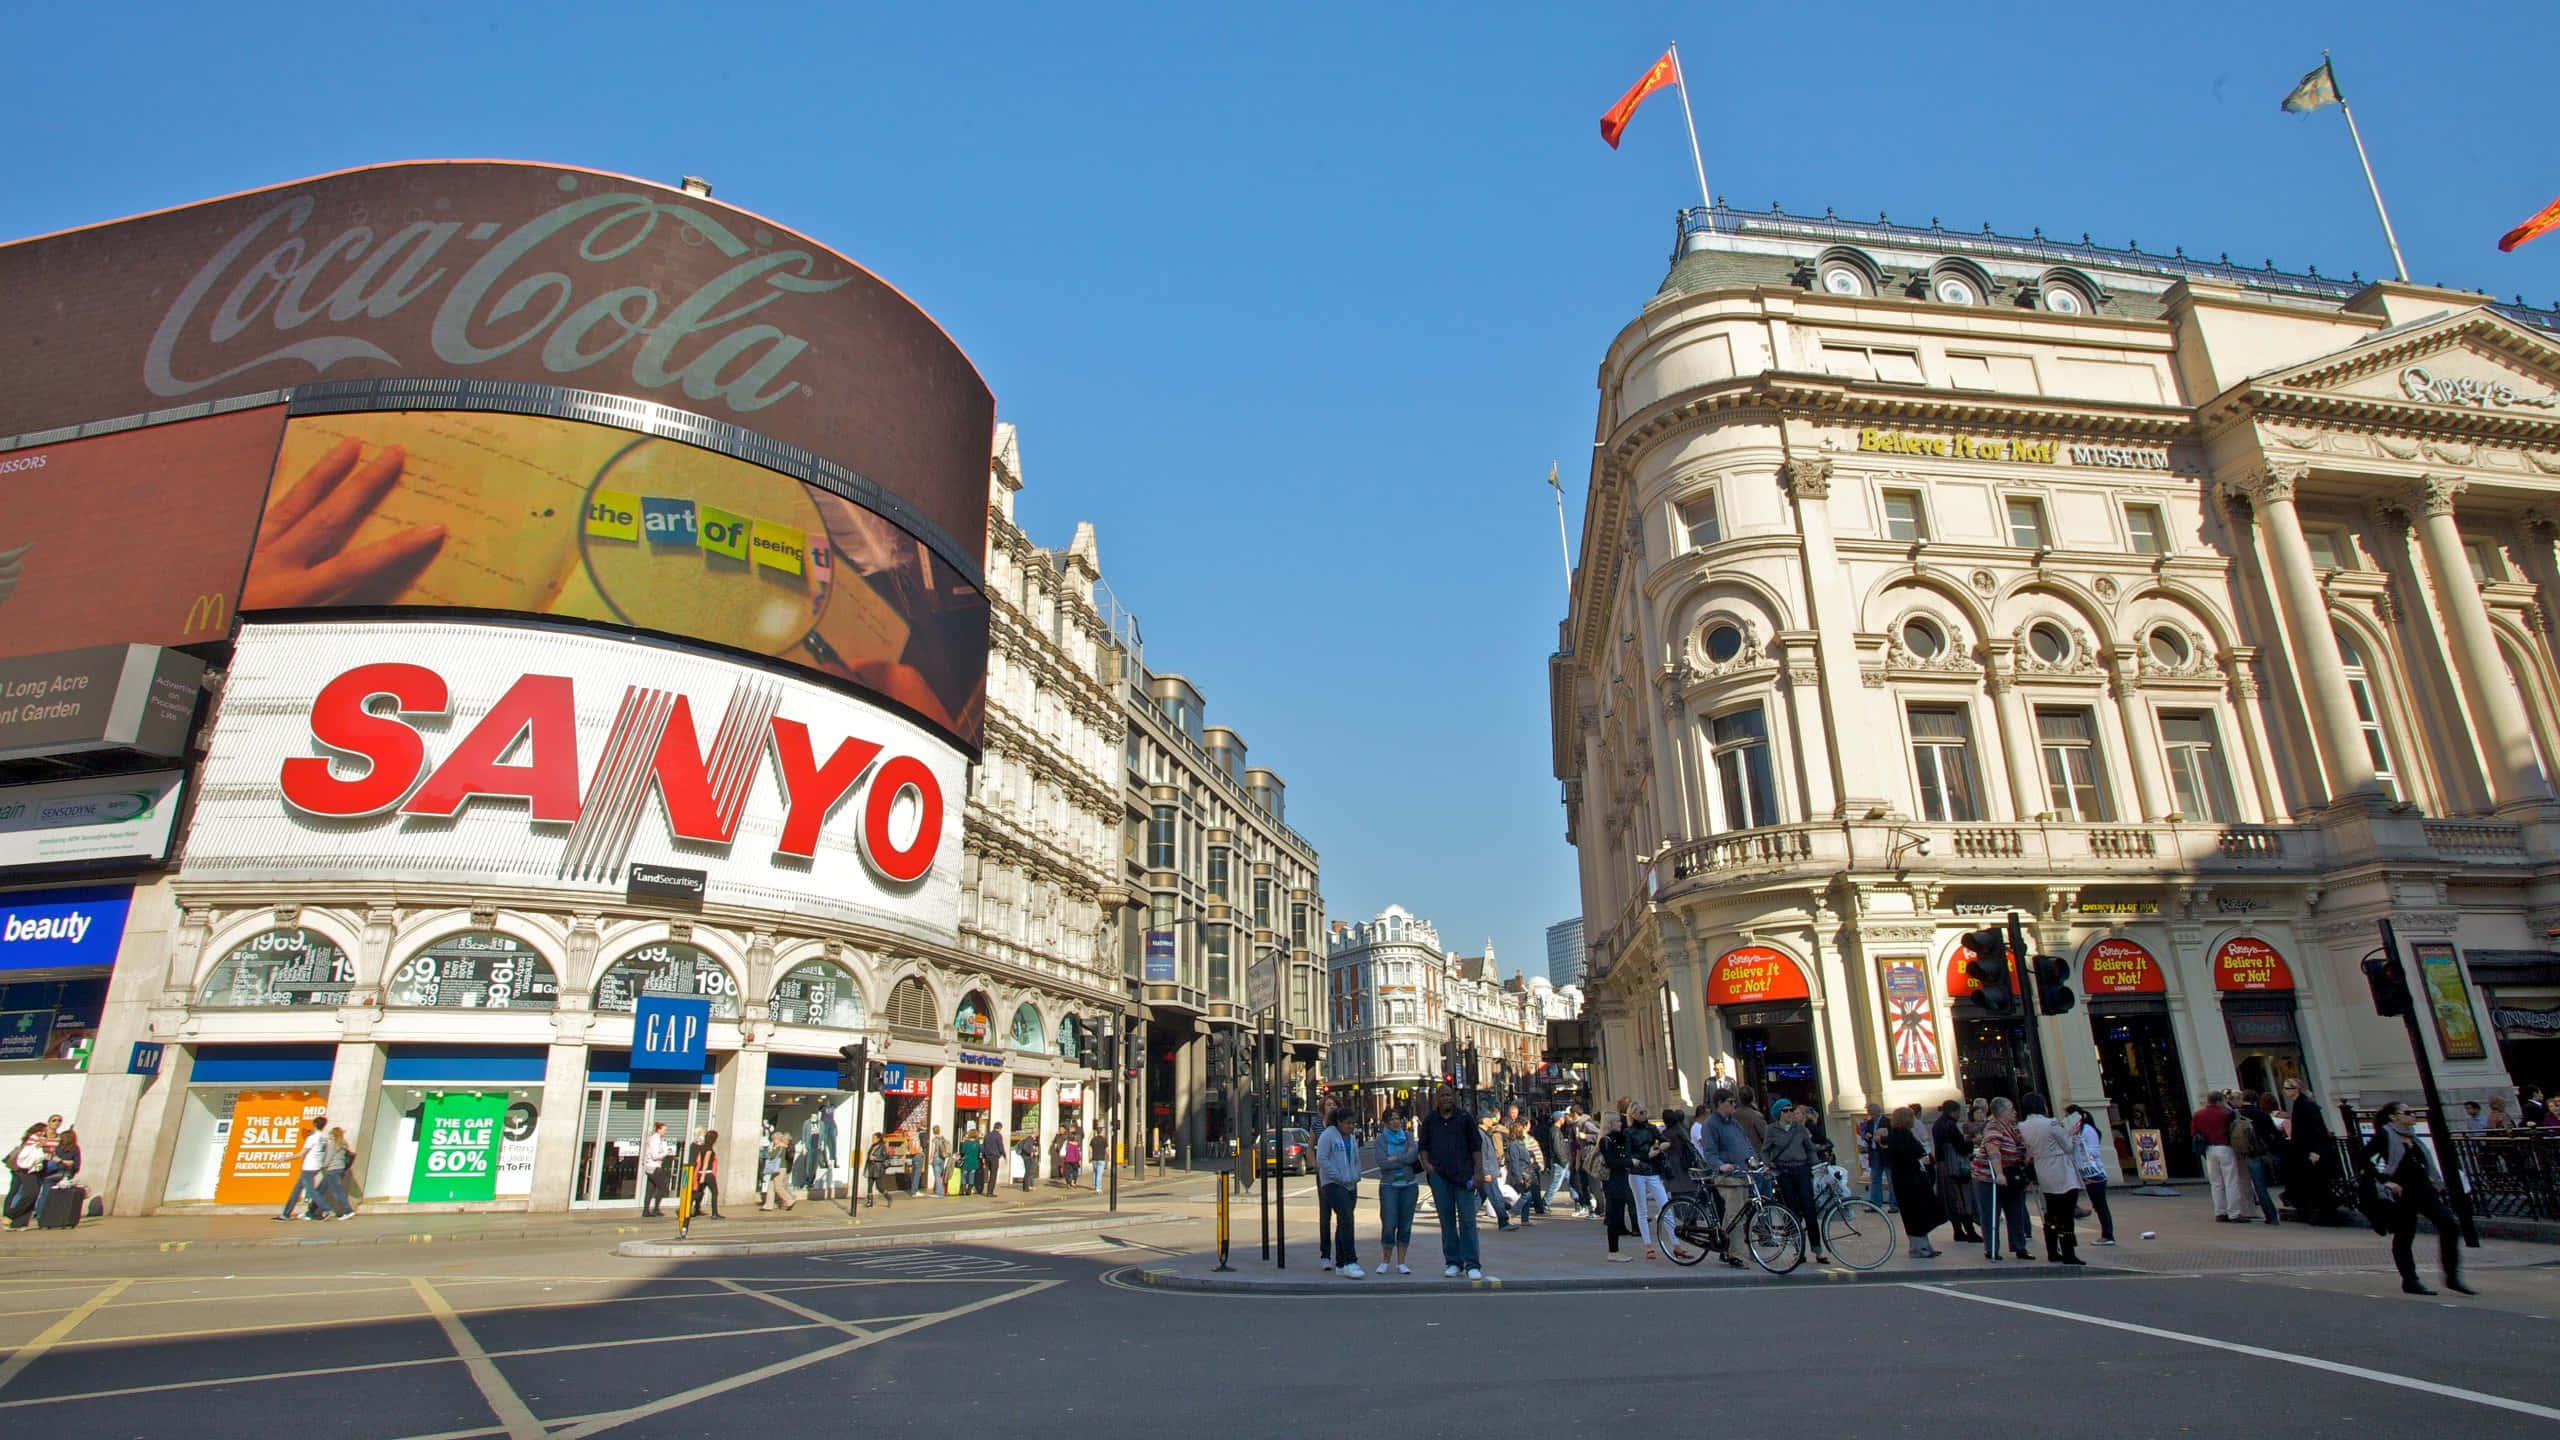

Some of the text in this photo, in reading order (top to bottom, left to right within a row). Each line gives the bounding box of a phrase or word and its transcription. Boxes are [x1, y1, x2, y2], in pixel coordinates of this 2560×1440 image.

[144, 192, 853, 412] Coca-Cola
[2400, 367, 2514, 409] Ripley's
[1859, 427, 2169, 470] Believe It or Not! MUSEUM
[588, 503, 634, 527] the
[645, 509, 697, 532] art
[704, 522, 744, 548] of
[752, 535, 803, 562] seeing
[6, 679, 48, 699] Long
[50, 675, 89, 693] Acre
[22, 702, 81, 722] Garden
[281, 662, 944, 883] SANYO
[42, 803, 96, 818] SENSODYNE
[4, 911, 92, 944] beauty
[2093, 957, 2147, 971] Believe It
[2223, 955, 2276, 969] Believe It
[1722, 962, 1780, 982] Believe It
[2102, 970, 2142, 985] or Not!
[2233, 969, 2271, 983] or Not!
[1729, 977, 1772, 994] or Not!
[645, 1013, 697, 1053] GAP
[137, 1049, 158, 1068] GAP
[884, 1070, 899, 1085] GAP
[957, 1081, 978, 1096] SALE
[1013, 1088, 1030, 1100] SALE
[246, 1116, 270, 1126] THE
[434, 1118, 461, 1128] THE
[242, 1127, 300, 1144] SALE
[431, 1129, 492, 1145] SALE
[427, 1150, 488, 1172] 60%
[506, 1163, 517, 1171] To
[518, 1163, 531, 1171] Fit
